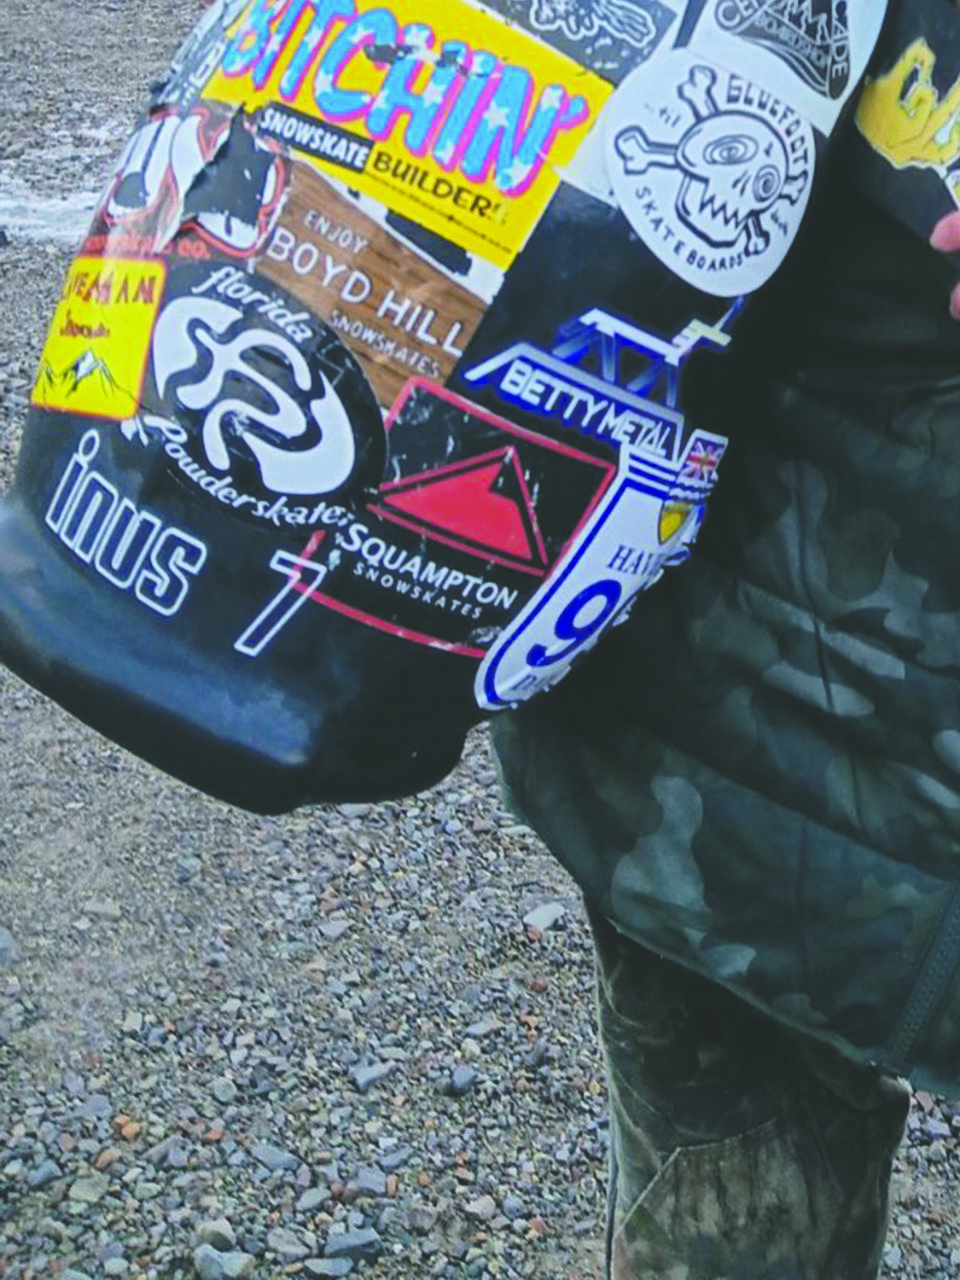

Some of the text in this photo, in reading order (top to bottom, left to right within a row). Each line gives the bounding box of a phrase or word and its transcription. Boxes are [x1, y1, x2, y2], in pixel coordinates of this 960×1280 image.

[258, 108, 371, 170] SNOWSKATE
[727, 74, 810, 166] BLUEFOOT
[303, 210, 369, 255] ENJOY
[635, 185, 744, 273] SKATEBOARDS
[191, 266, 314, 344] florida
[267, 227, 464, 359] BOYD HILL
[330, 309, 442, 379] SNOWSKATES
[340, 523, 518, 610] SQUAMPTON
[353, 562, 483, 619] SNOWSKATES
[526, 579, 622, 667] 9
